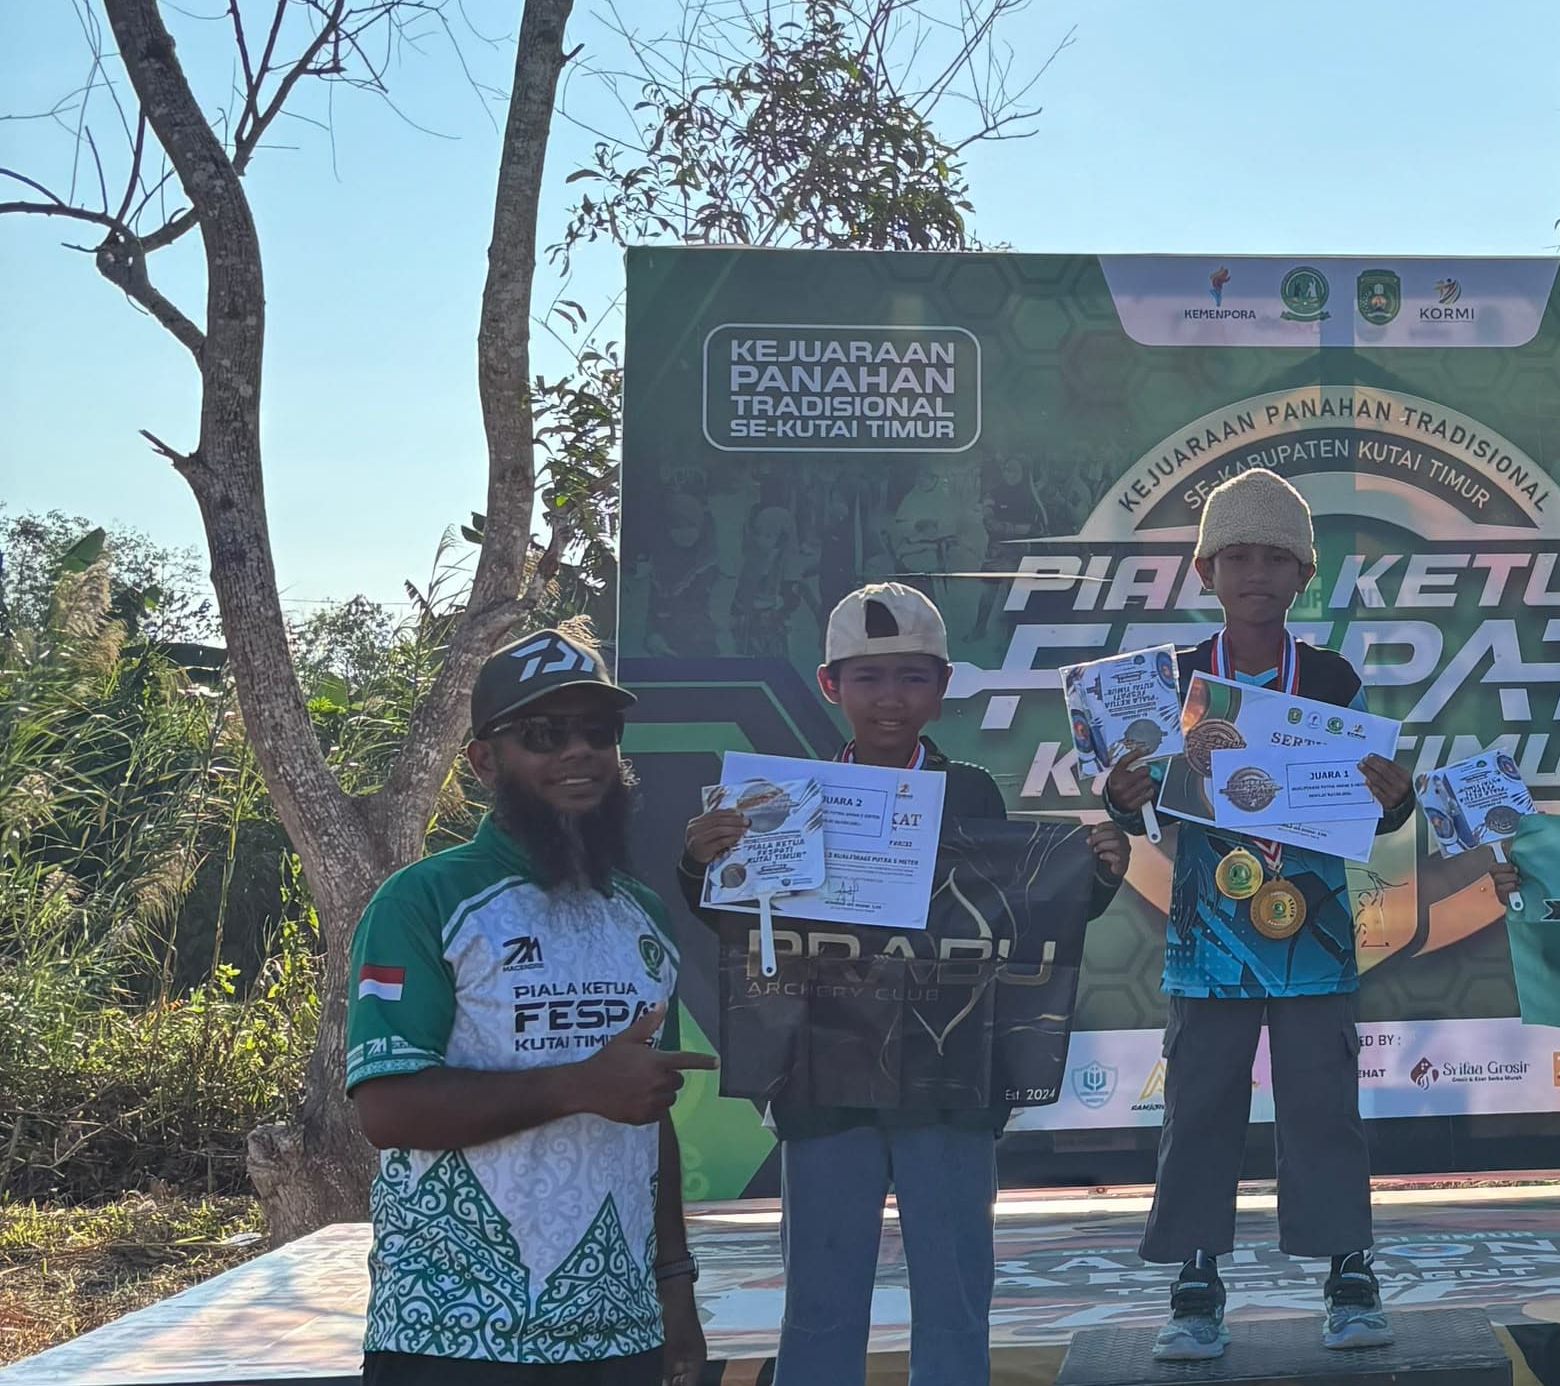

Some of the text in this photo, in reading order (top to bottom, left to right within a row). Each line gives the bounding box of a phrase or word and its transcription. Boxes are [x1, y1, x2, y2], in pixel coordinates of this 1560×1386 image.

[1184, 309, 1257, 319] KEMENPORA
[1420, 308, 1475, 320] KORMI
[730, 340, 955, 365] KEJUARAAN
[730, 365, 955, 393] PANAHAN
[730, 395, 955, 418] TRADISIONAL
[730, 419, 955, 439] SE-KUTAI TIMUR
[1119, 397, 1551, 513] KEJUARAAN PANAHAN TRADISIONAL
[1358, 441, 1423, 471] KUTAI
[1429, 459, 1491, 509] TIMUR
[1003, 555, 1222, 612] PIAL
[1310, 770, 1350, 781] JUARA 1
[855, 798, 863, 806] 2
[513, 981, 638, 999] PIALA KETUA
[747, 981, 939, 1002] ARCHERY CLUB
[515, 999, 656, 1033] FESPA
[515, 1036, 570, 1052] KUTAI
[1378, 1034, 1394, 1046] BY
[1487, 1060, 1530, 1075] Grosir
[1026, 1088, 1056, 1101] 2024
